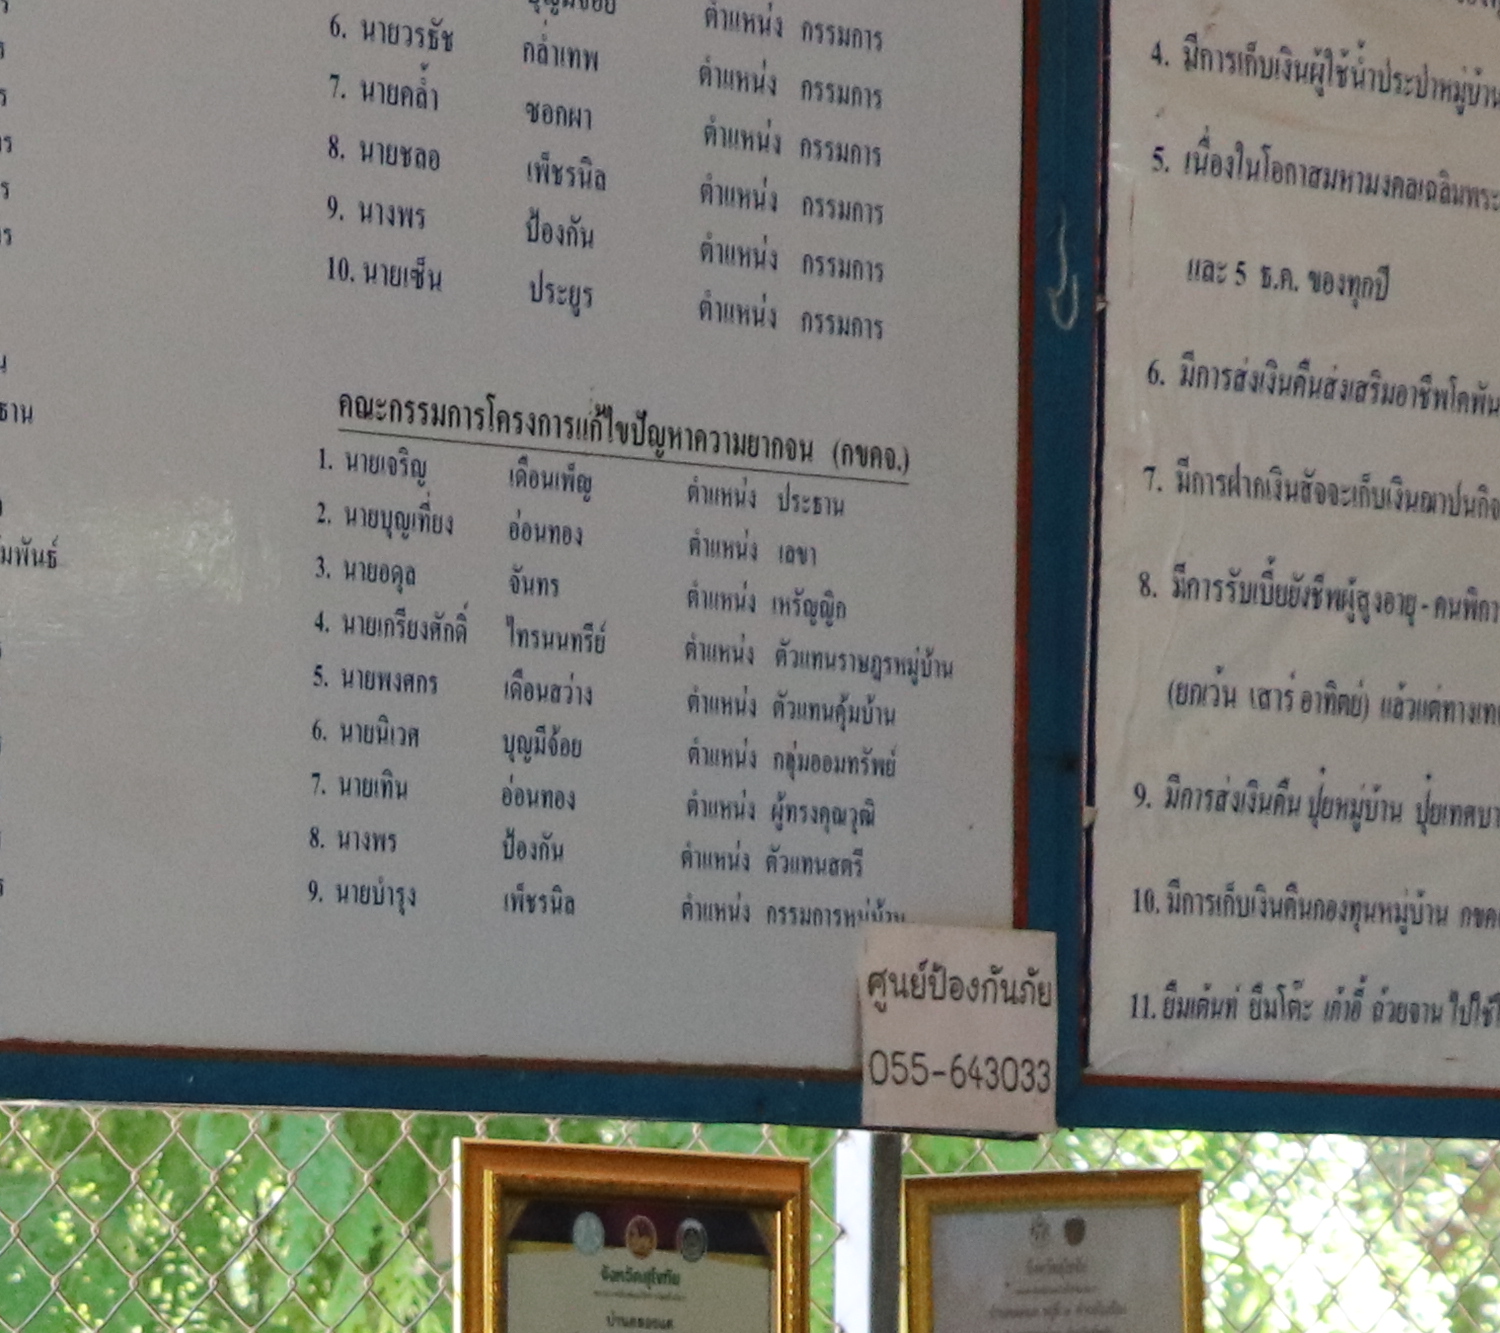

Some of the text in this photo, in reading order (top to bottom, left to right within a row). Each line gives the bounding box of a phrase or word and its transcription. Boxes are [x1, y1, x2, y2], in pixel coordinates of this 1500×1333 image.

[867, 958, 1053, 1013] ศูนย์ป้องกันภัย
[869, 1049, 1052, 1093] 055-643033
